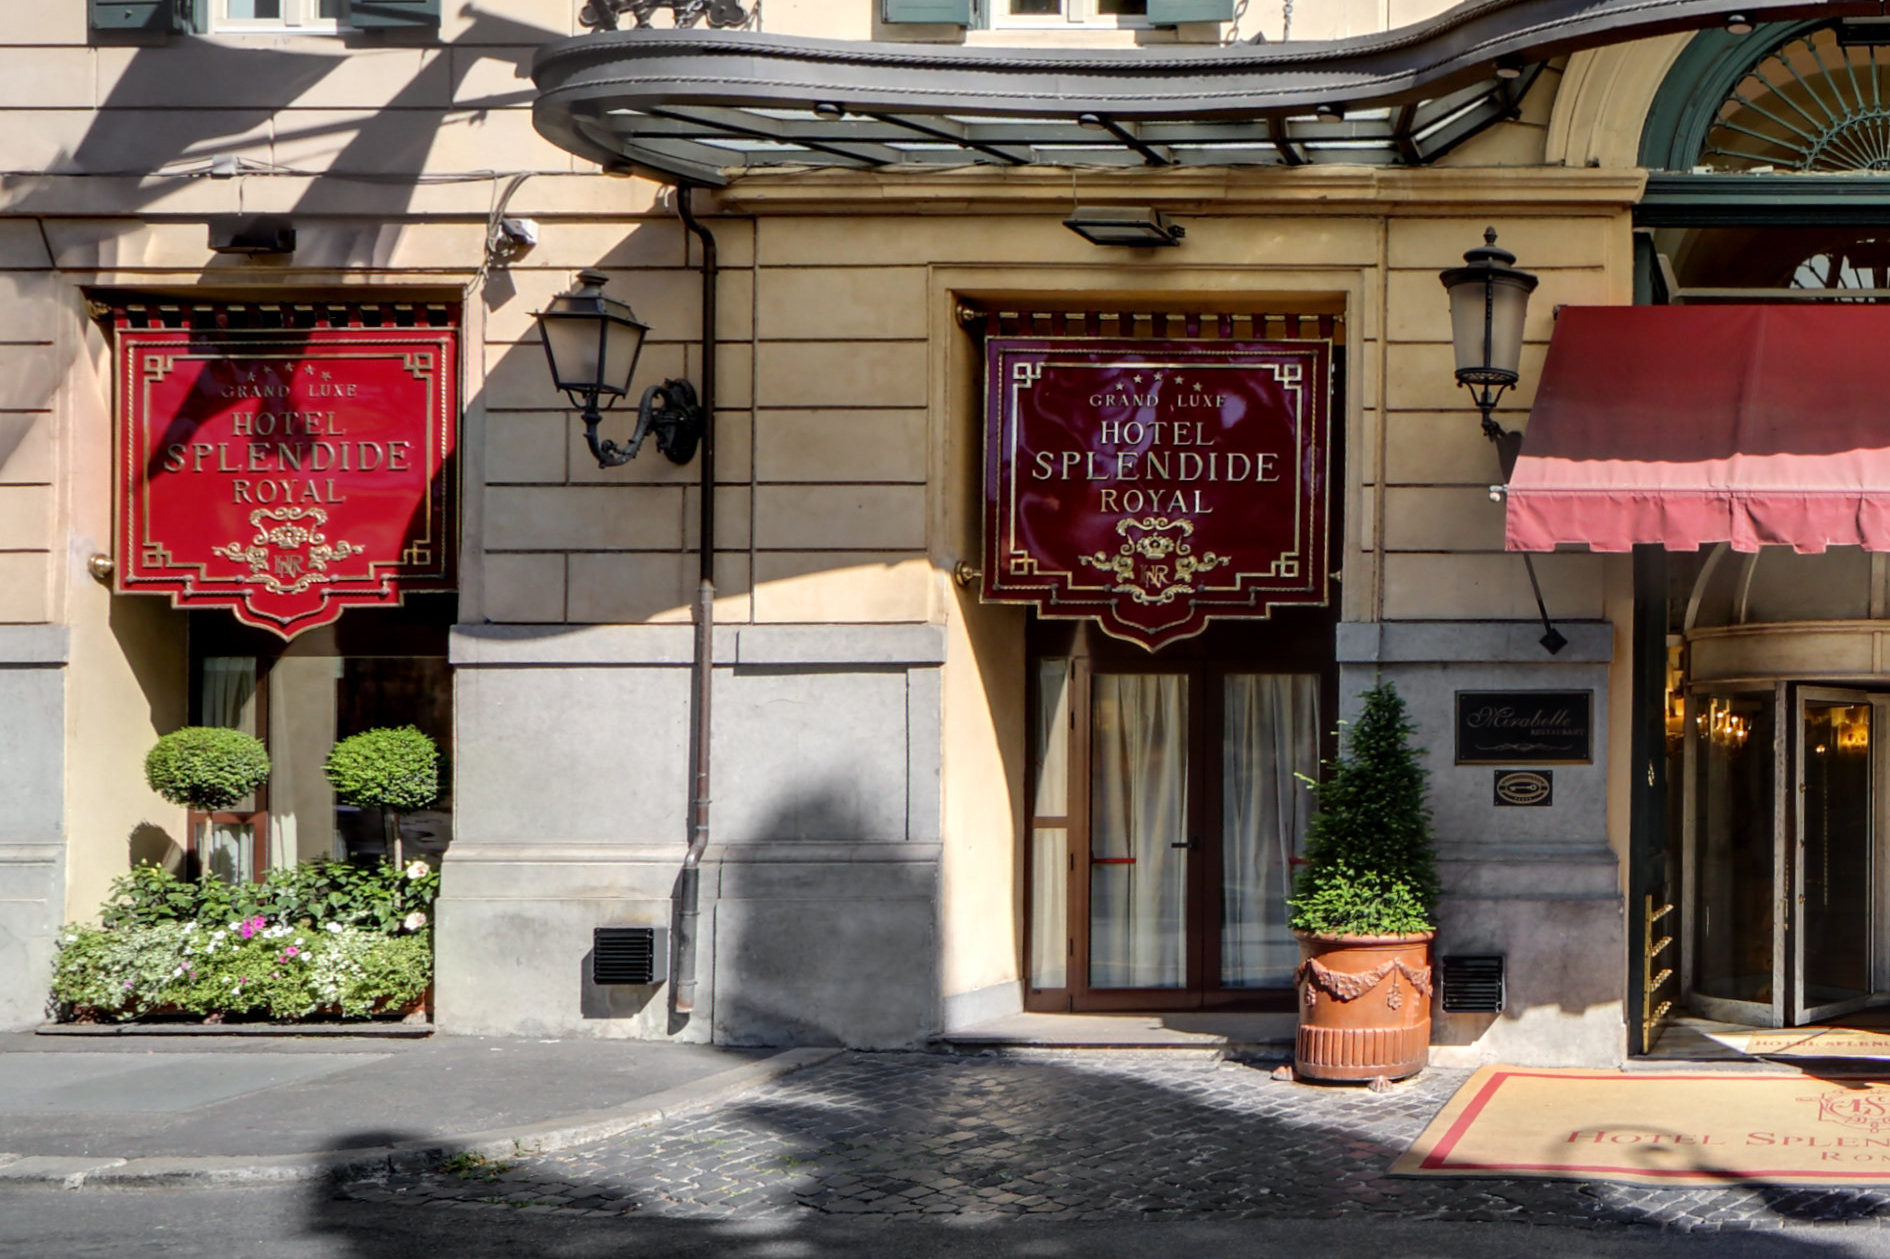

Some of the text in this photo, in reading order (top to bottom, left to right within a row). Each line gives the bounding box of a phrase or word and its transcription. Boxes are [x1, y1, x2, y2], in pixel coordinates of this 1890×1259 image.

[222, 384, 357, 398] GRAND LUXE
[1089, 394, 1227, 408] GRAND LUXE
[231, 411, 347, 437] HOTEL
[1100, 420, 1216, 447] HOTEL
[162, 441, 412, 473] SPLENDIDE
[1031, 450, 1281, 482] SPLENDIDE
[231, 478, 347, 504] ROYAL
[1100, 489, 1214, 515] ROYAL
[1466, 706, 1573, 728] Mirabelle
[1566, 1130, 1726, 1145] HOTEL
